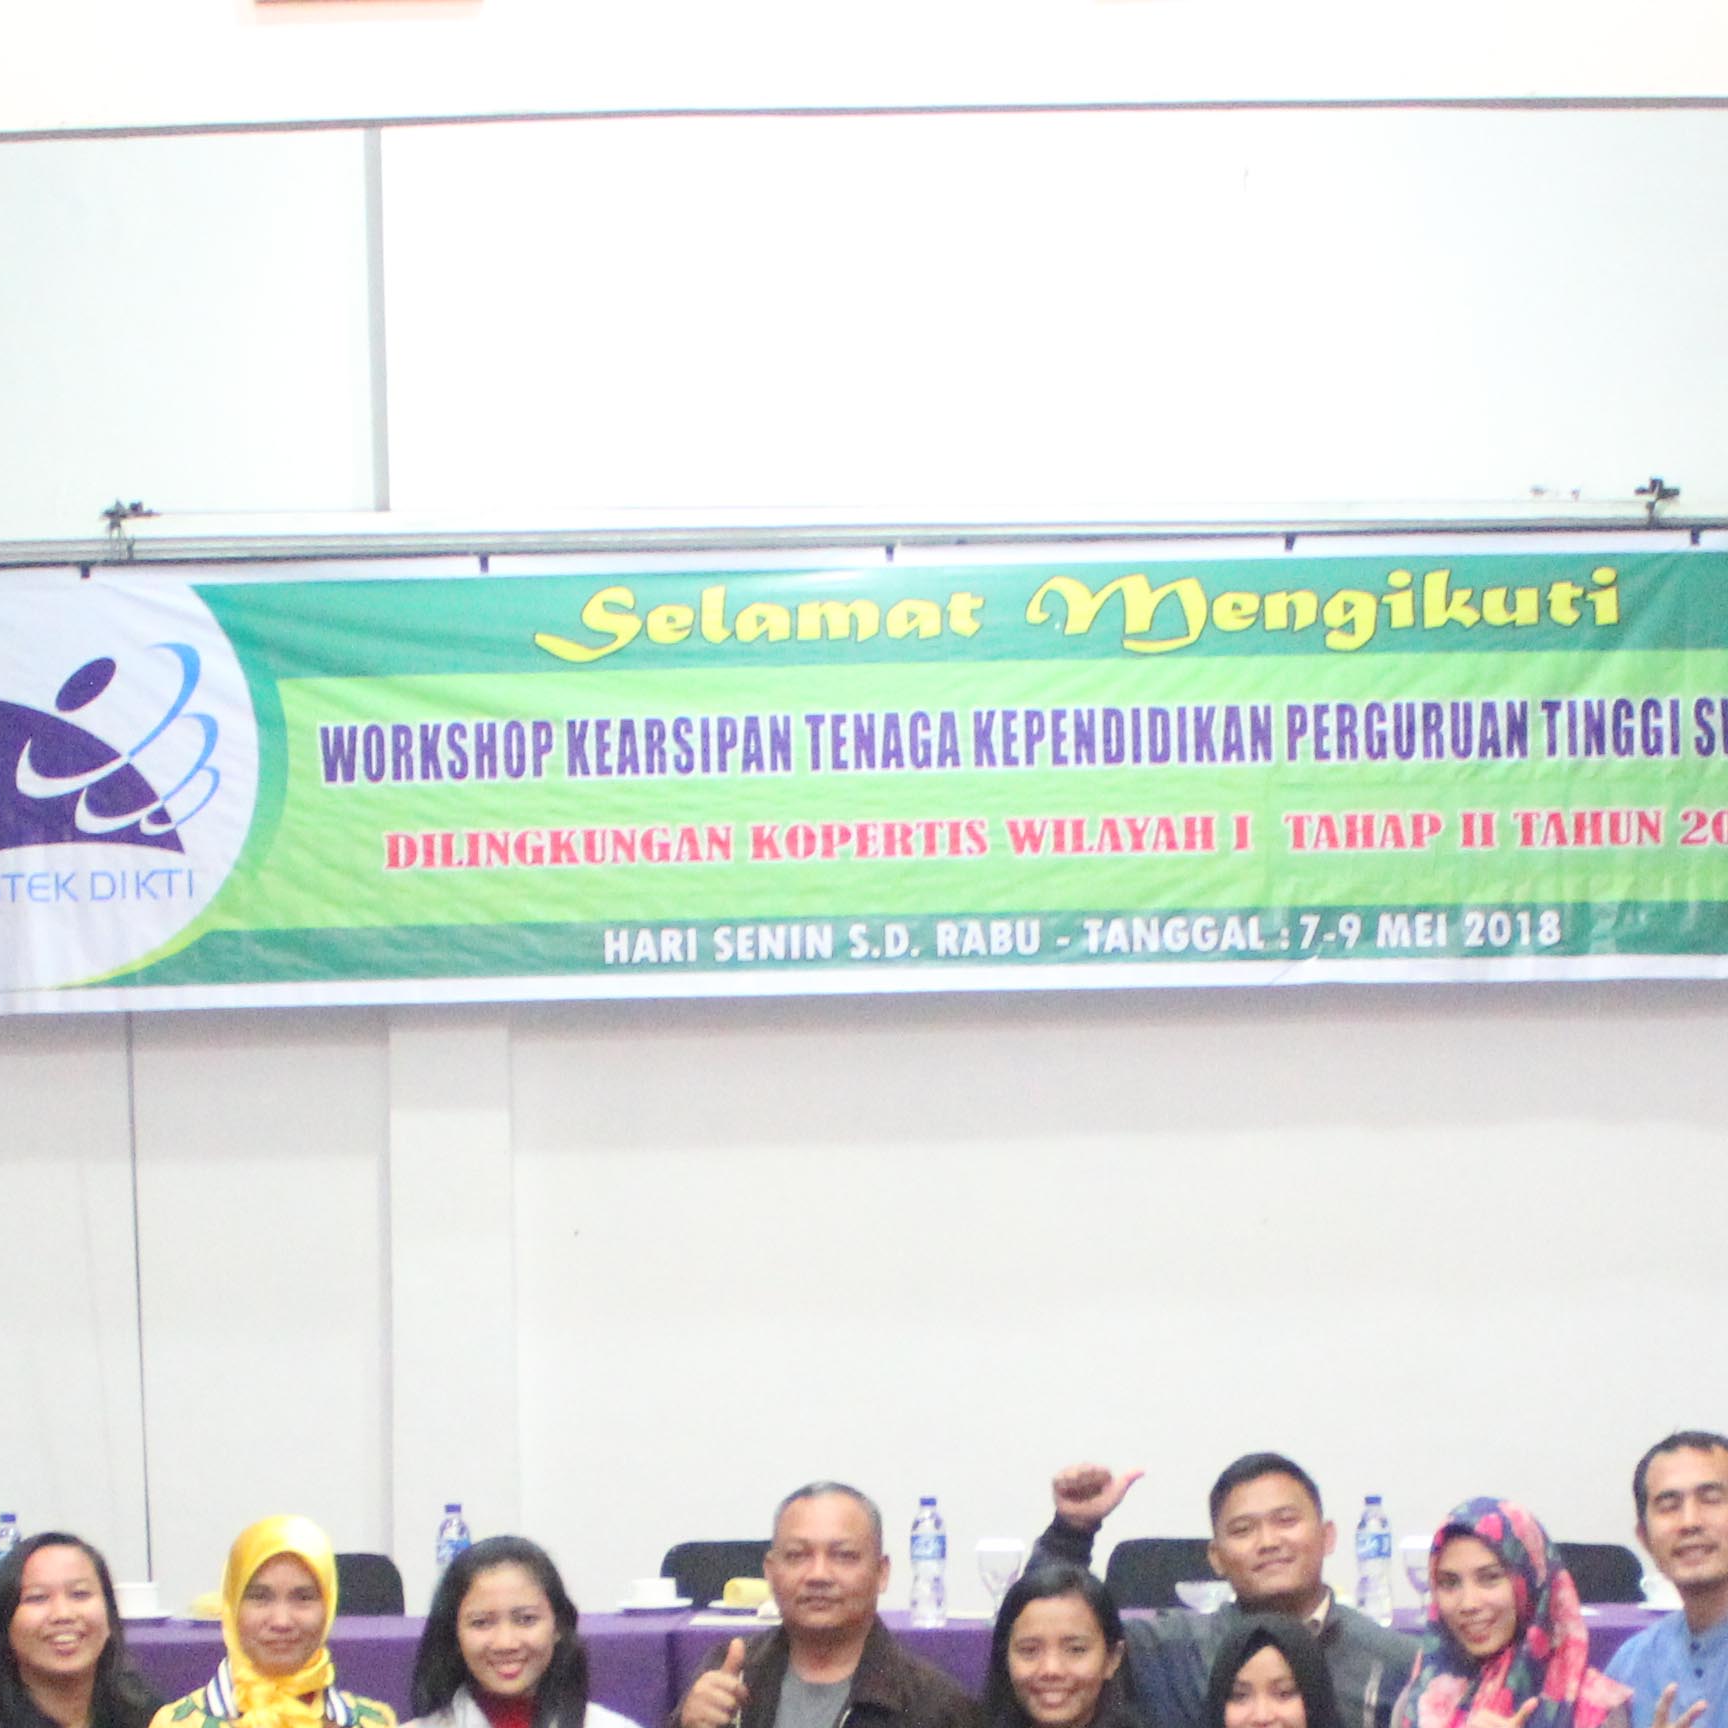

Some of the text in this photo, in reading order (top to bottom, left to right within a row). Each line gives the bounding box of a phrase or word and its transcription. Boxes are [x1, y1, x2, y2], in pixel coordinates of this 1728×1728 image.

[533, 566, 1620, 664] Selamat Mengikuti
[319, 719, 555, 784] WORKSHOP
[565, 713, 793, 778] KEARSIPAN
[804, 710, 962, 771] TENAGA
[972, 703, 1272, 768] KEPENDIDIKAN
[1286, 701, 1529, 762] PERGURUAN
[1541, 699, 1680, 757] TINGGI
[384, 825, 734, 870] DILINGKUNGAN
[749, 818, 989, 863] KOPERTIS
[1006, 814, 1216, 856] WILAYAH
[1233, 814, 1253, 851] I
[1283, 810, 1443, 851] TAHAP
[1460, 810, 1496, 848] II
[1514, 809, 1663, 848] TAHUN
[90, 868, 195, 901] DIKTI
[602, 928, 698, 964] HARI
[713, 923, 833, 962] SENIN
[848, 922, 921, 958] S.D.
[936, 919, 1041, 957] RABU
[1083, 915, 1265, 953] TANGGAL
[1376, 911, 1448, 948] MEI
[1463, 910, 1562, 947] 2018
